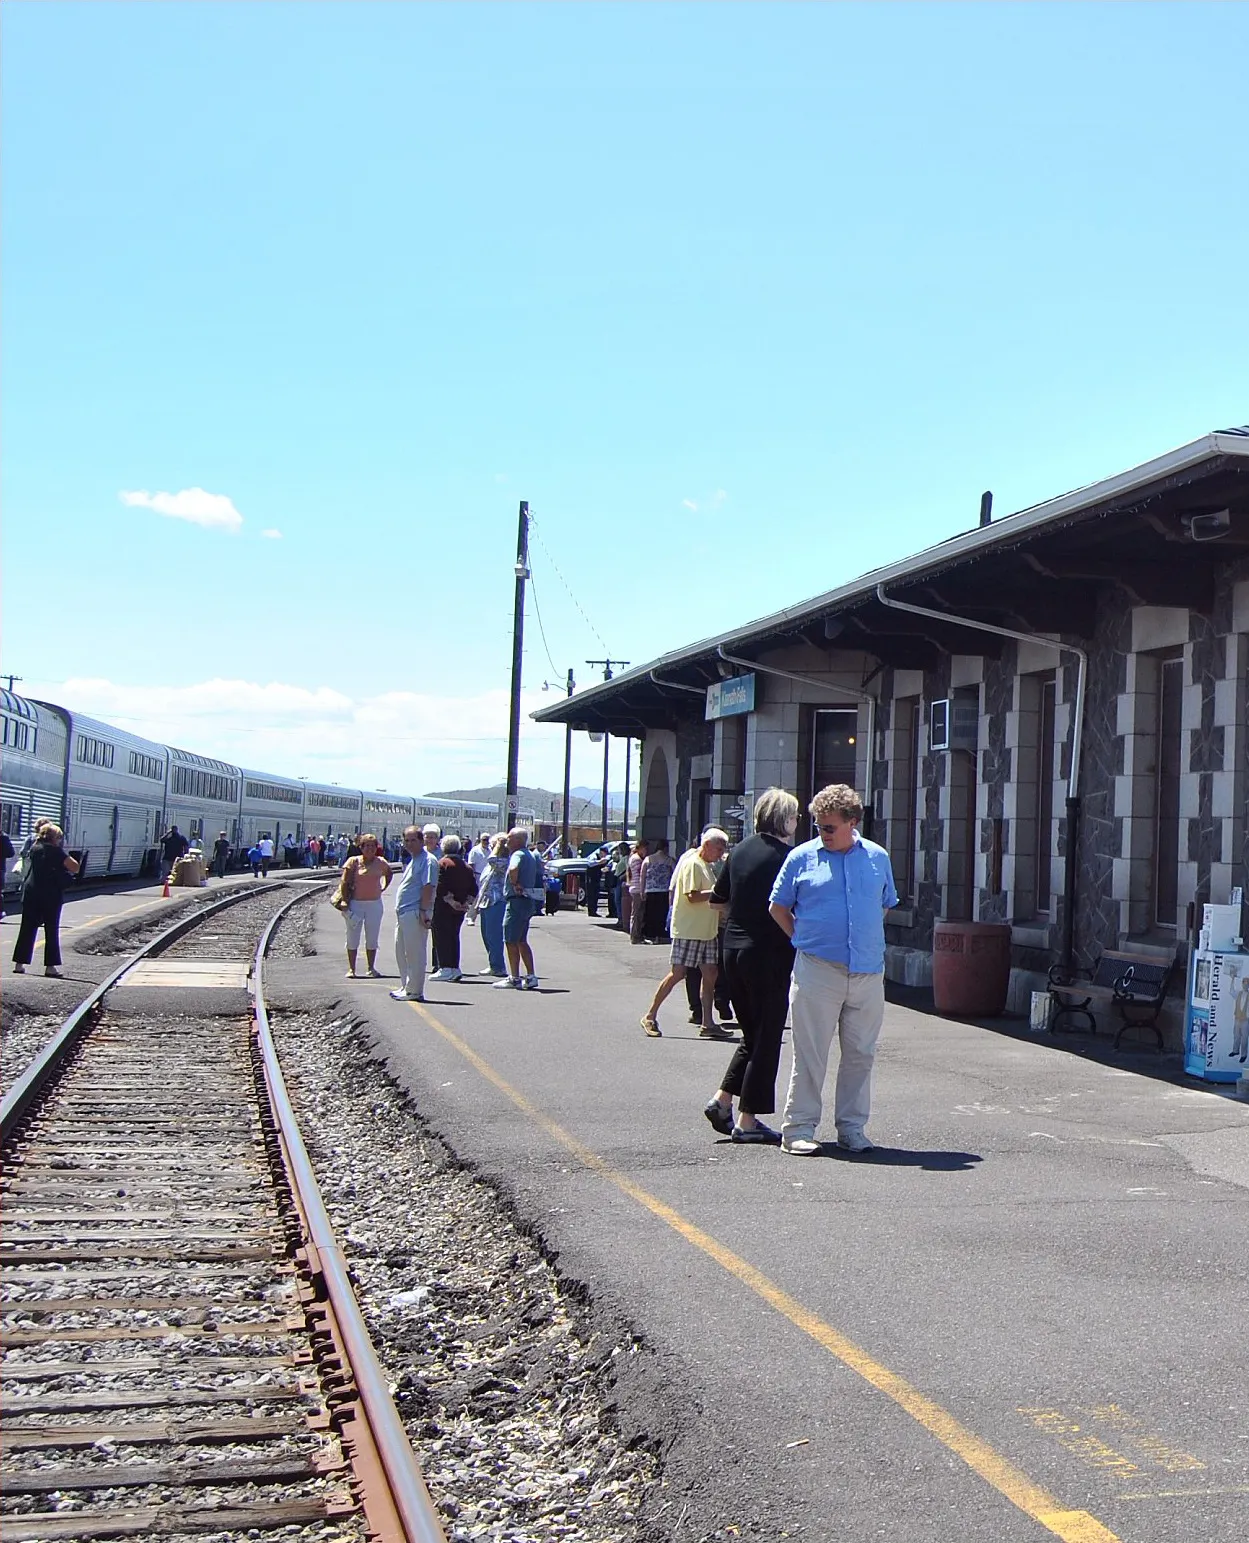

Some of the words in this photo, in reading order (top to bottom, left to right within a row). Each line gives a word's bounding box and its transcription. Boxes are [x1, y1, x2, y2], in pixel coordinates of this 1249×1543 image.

[1212, 955, 1223, 1001] Herald
[1209, 1005, 1217, 1027] and
[1206, 1031, 1218, 1068] News
